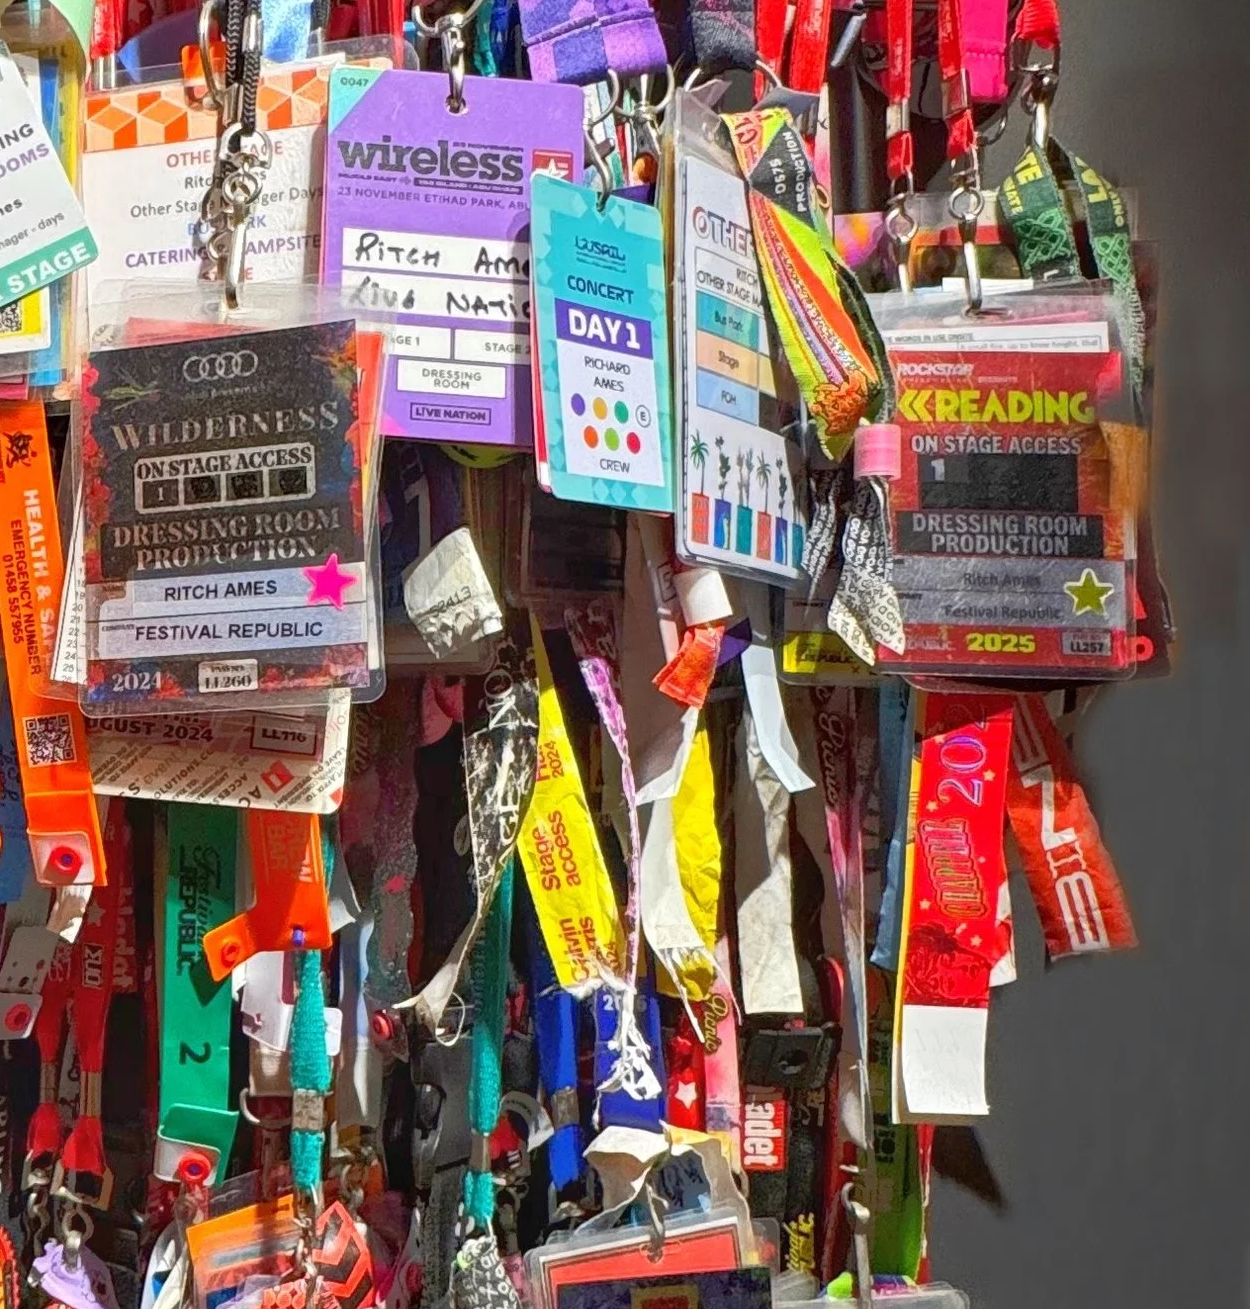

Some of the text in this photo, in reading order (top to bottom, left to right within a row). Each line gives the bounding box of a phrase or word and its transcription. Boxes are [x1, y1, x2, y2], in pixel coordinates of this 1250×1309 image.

[340, 78, 369, 87] 0047
[337, 137, 525, 181] wireless
[782, 130, 806, 212] PRODUCTION
[338, 186, 352, 197] 23
[354, 188, 420, 201] NOVEMBER
[423, 193, 468, 206] ETIHAD
[471, 198, 505, 209] PARK,
[7, 243, 91, 295] STAGE
[567, 275, 634, 304] CONCERT
[568, 311, 640, 347] DAY 1
[422, 369, 481, 380] DRESSING
[584, 356, 631, 375] RICHARD
[433, 378, 469, 389] ROOM
[594, 376, 624, 391] AMES
[936, 390, 1095, 426] READING
[110, 402, 339, 451] WILDERNESS
[911, 436, 1081, 455] ON STAGE ACCESS
[599, 458, 630, 473] CREW
[23, 489, 51, 579] HEALTH
[112, 507, 341, 549] DRESSING ROOM
[912, 512, 1087, 536] DRESSING ROOM
[136, 538, 316, 570] PRODUCTION
[932, 534, 1068, 555] PRODUCTION
[10, 519, 43, 676] EMERGENCY NUMBER
[165, 581, 278, 600] RITCH AMES
[135, 621, 323, 640] FESTIVAL REPUBLIC
[966, 632, 1036, 653] 2025
[111, 673, 162, 692] 2024
[527, 823, 562, 892] Stage
[552, 810, 580, 887] access
[700, 993, 730, 1054] Picnic
